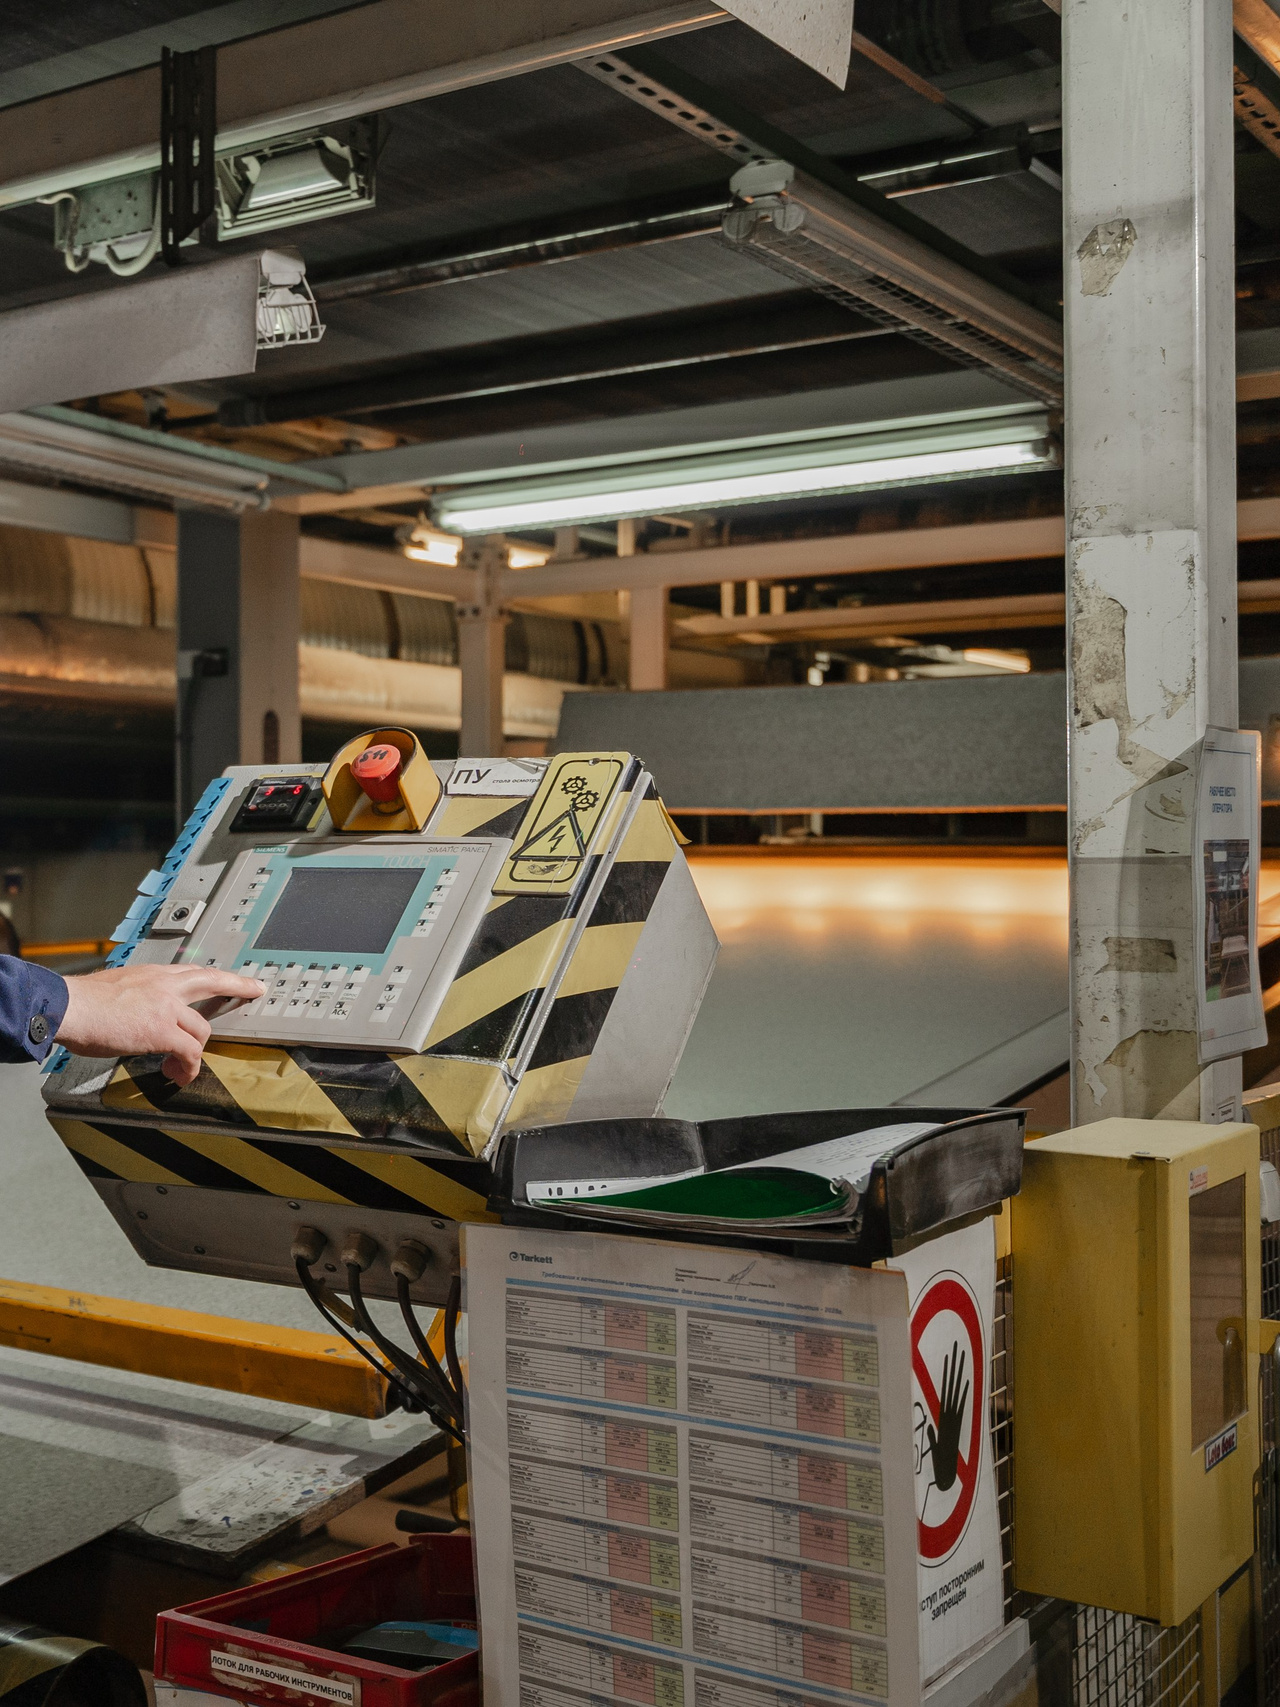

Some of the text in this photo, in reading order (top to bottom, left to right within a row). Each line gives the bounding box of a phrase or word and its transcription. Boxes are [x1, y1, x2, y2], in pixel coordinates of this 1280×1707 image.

[452, 768, 492, 785] ПУ
[382, 855, 433, 868] TOUCH
[520, 1253, 553, 1264] Tarkett
[919, 1559, 985, 1611] ступ посторонним
[932, 1587, 967, 1621] запрещен
[211, 1656, 353, 1700] ЛОТОК ДЛЯ РАБОЧИХ ИНСТРУМЕНТОВ
